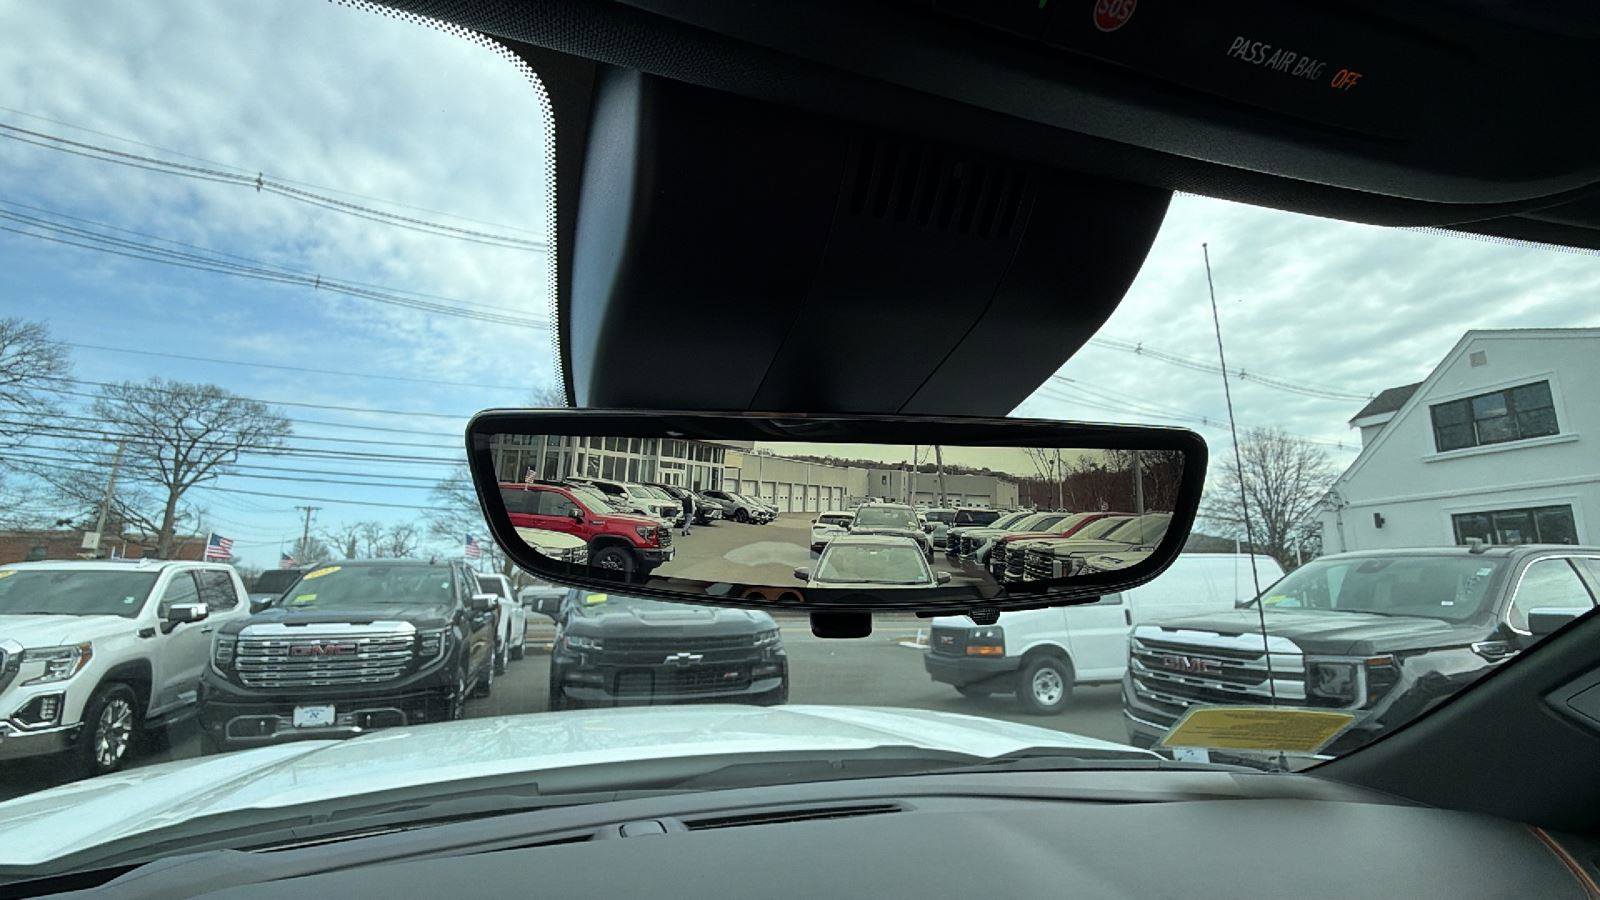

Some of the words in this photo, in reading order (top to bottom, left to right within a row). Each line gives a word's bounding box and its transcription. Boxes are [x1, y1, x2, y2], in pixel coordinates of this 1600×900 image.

[1098, 0, 1134, 20] SOS
[1226, 36, 1271, 64] PASS
[1264, 49, 1296, 73] AIR
[1291, 57, 1327, 80] BAG
[1331, 69, 1363, 90] OFF
[291, 644, 356, 656] GMC
[1163, 653, 1222, 676] GMC
